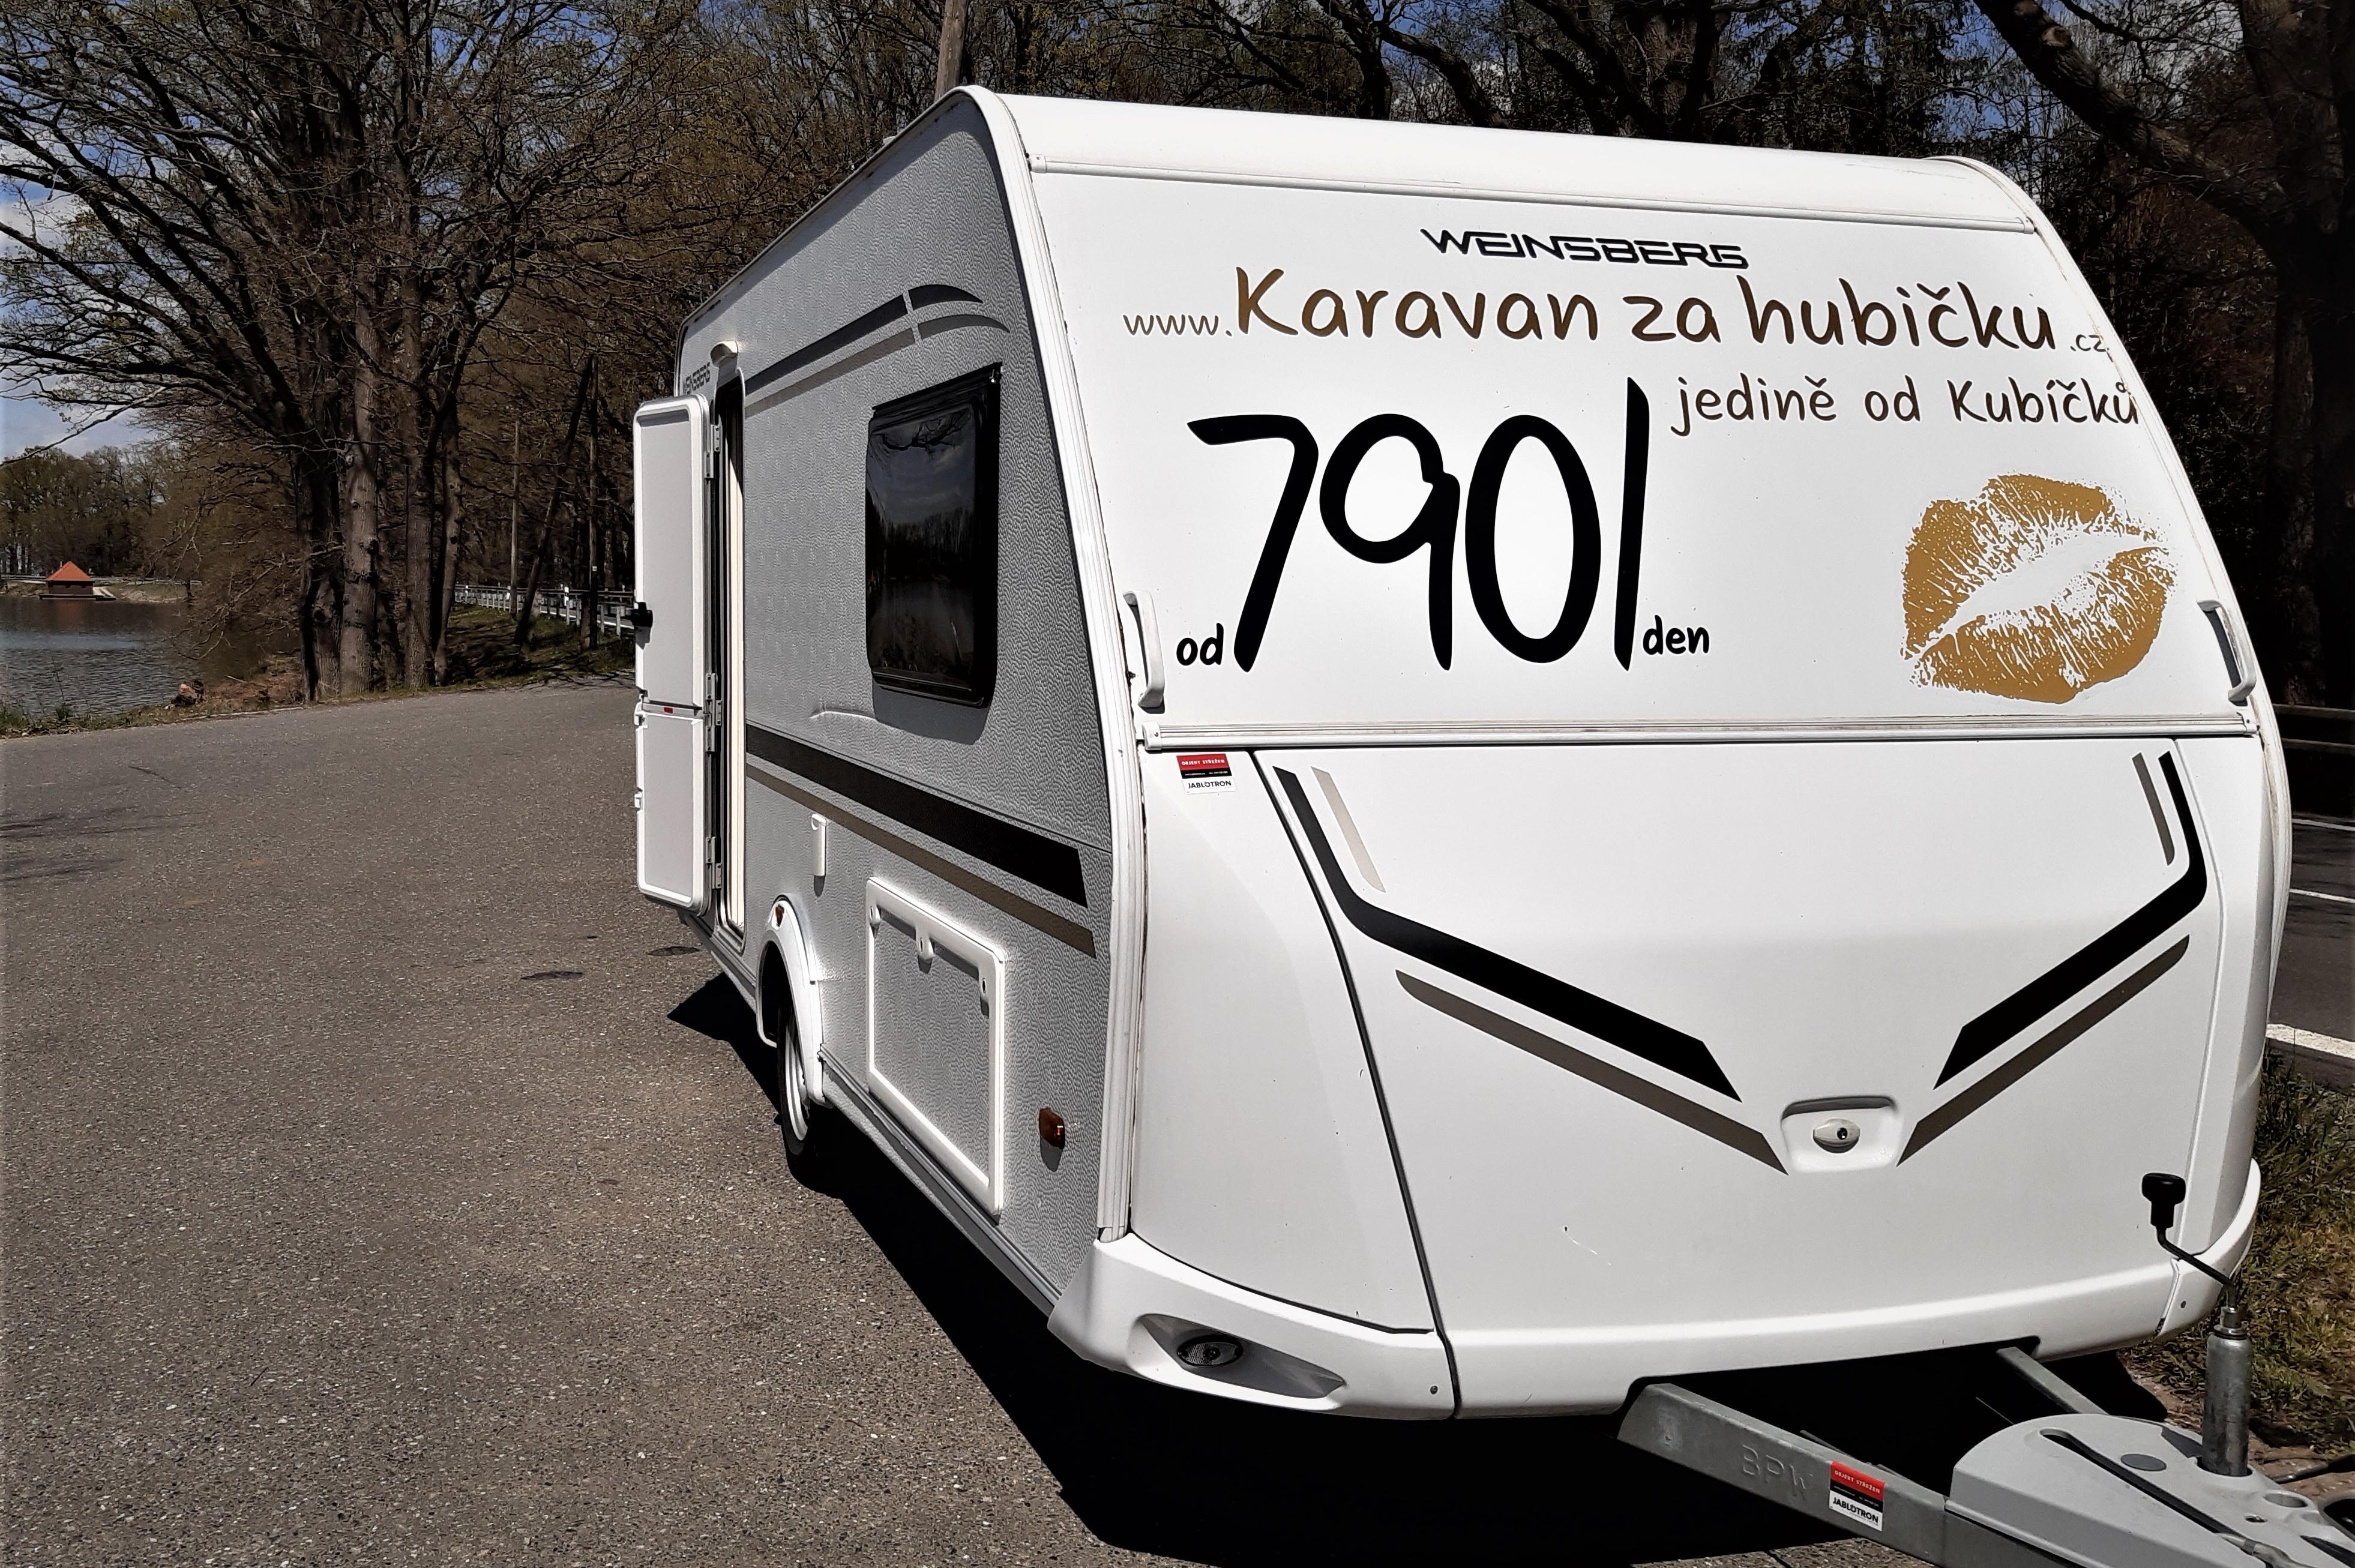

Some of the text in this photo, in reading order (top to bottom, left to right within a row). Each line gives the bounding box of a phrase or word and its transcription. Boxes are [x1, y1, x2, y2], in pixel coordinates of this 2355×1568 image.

[1420, 229, 1749, 269] WEINSBERG
[1622, 296, 1721, 343] za
[1670, 372, 2140, 437] jedině od Kubíčků
[1176, 622, 1225, 666] od
[1833, 1497, 1878, 1523] JABLOTRON
